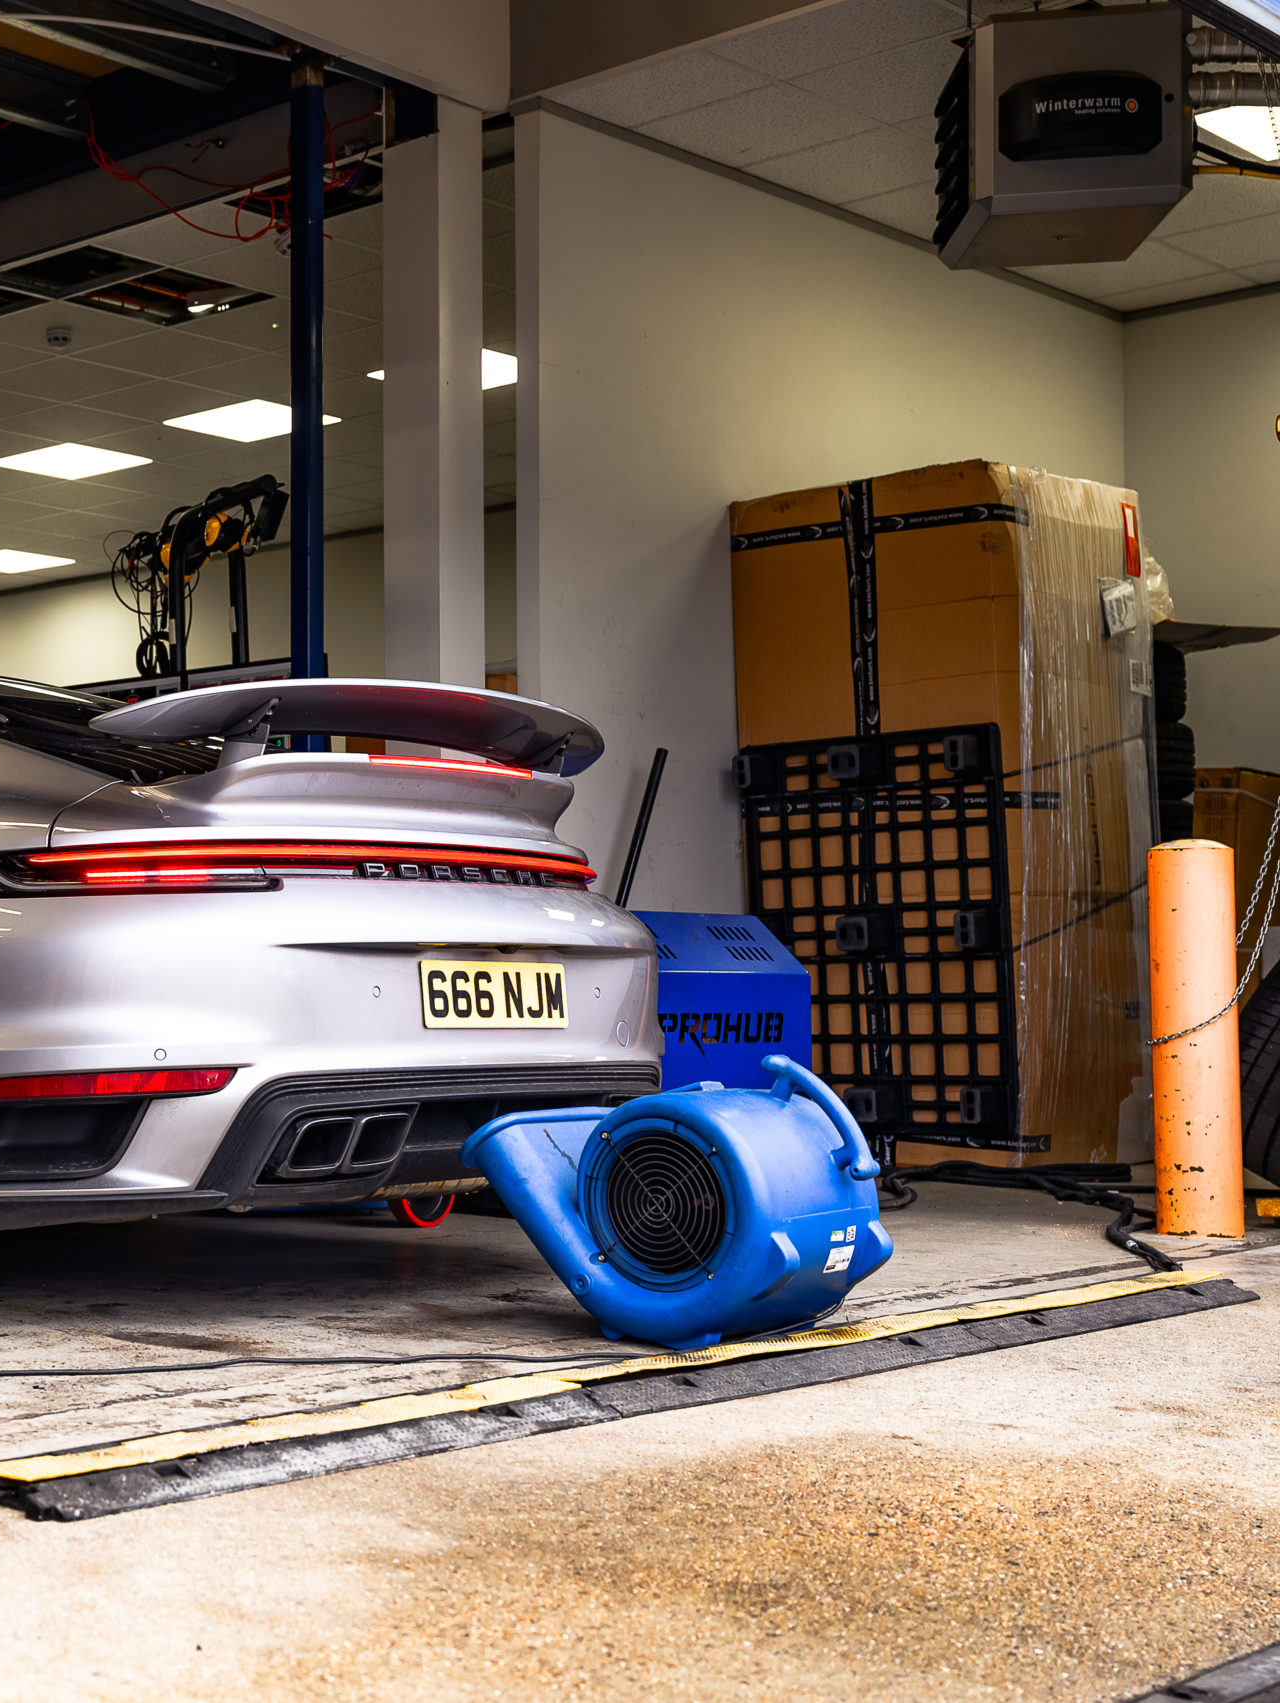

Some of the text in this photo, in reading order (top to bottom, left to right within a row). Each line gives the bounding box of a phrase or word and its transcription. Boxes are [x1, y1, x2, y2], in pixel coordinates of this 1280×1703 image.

[1035, 97, 1121, 114] Winterwarm
[362, 862, 553, 886] PORSCHE
[428, 970, 565, 1019] 666 NJM
[658, 1012, 784, 1058] PROHUB
